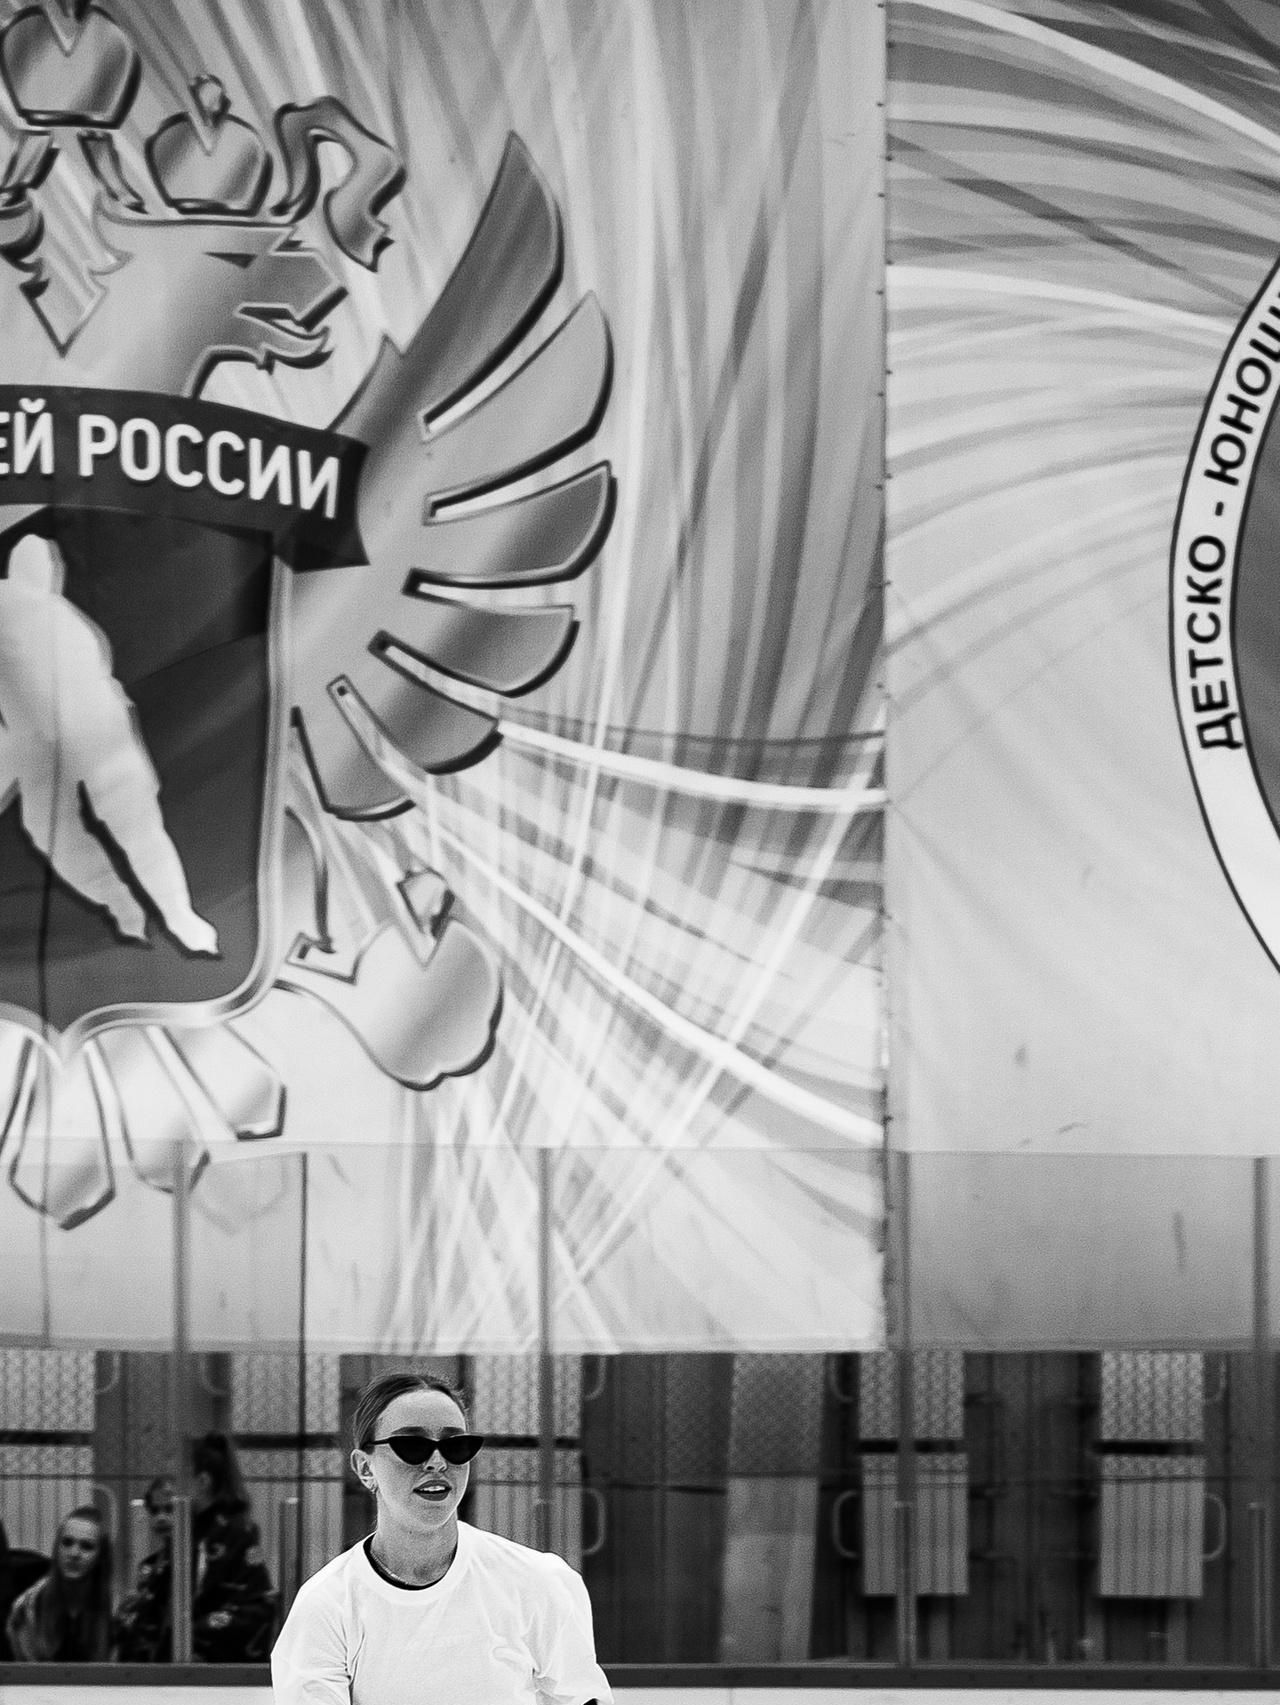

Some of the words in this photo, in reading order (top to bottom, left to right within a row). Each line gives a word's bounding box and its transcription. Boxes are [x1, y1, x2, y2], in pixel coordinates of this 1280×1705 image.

[78, 413, 339, 519] РОССИИ
[1204, 293, 1280, 486] ЮНОШ
[1187, 535, 1244, 750] ДЕТСКО
